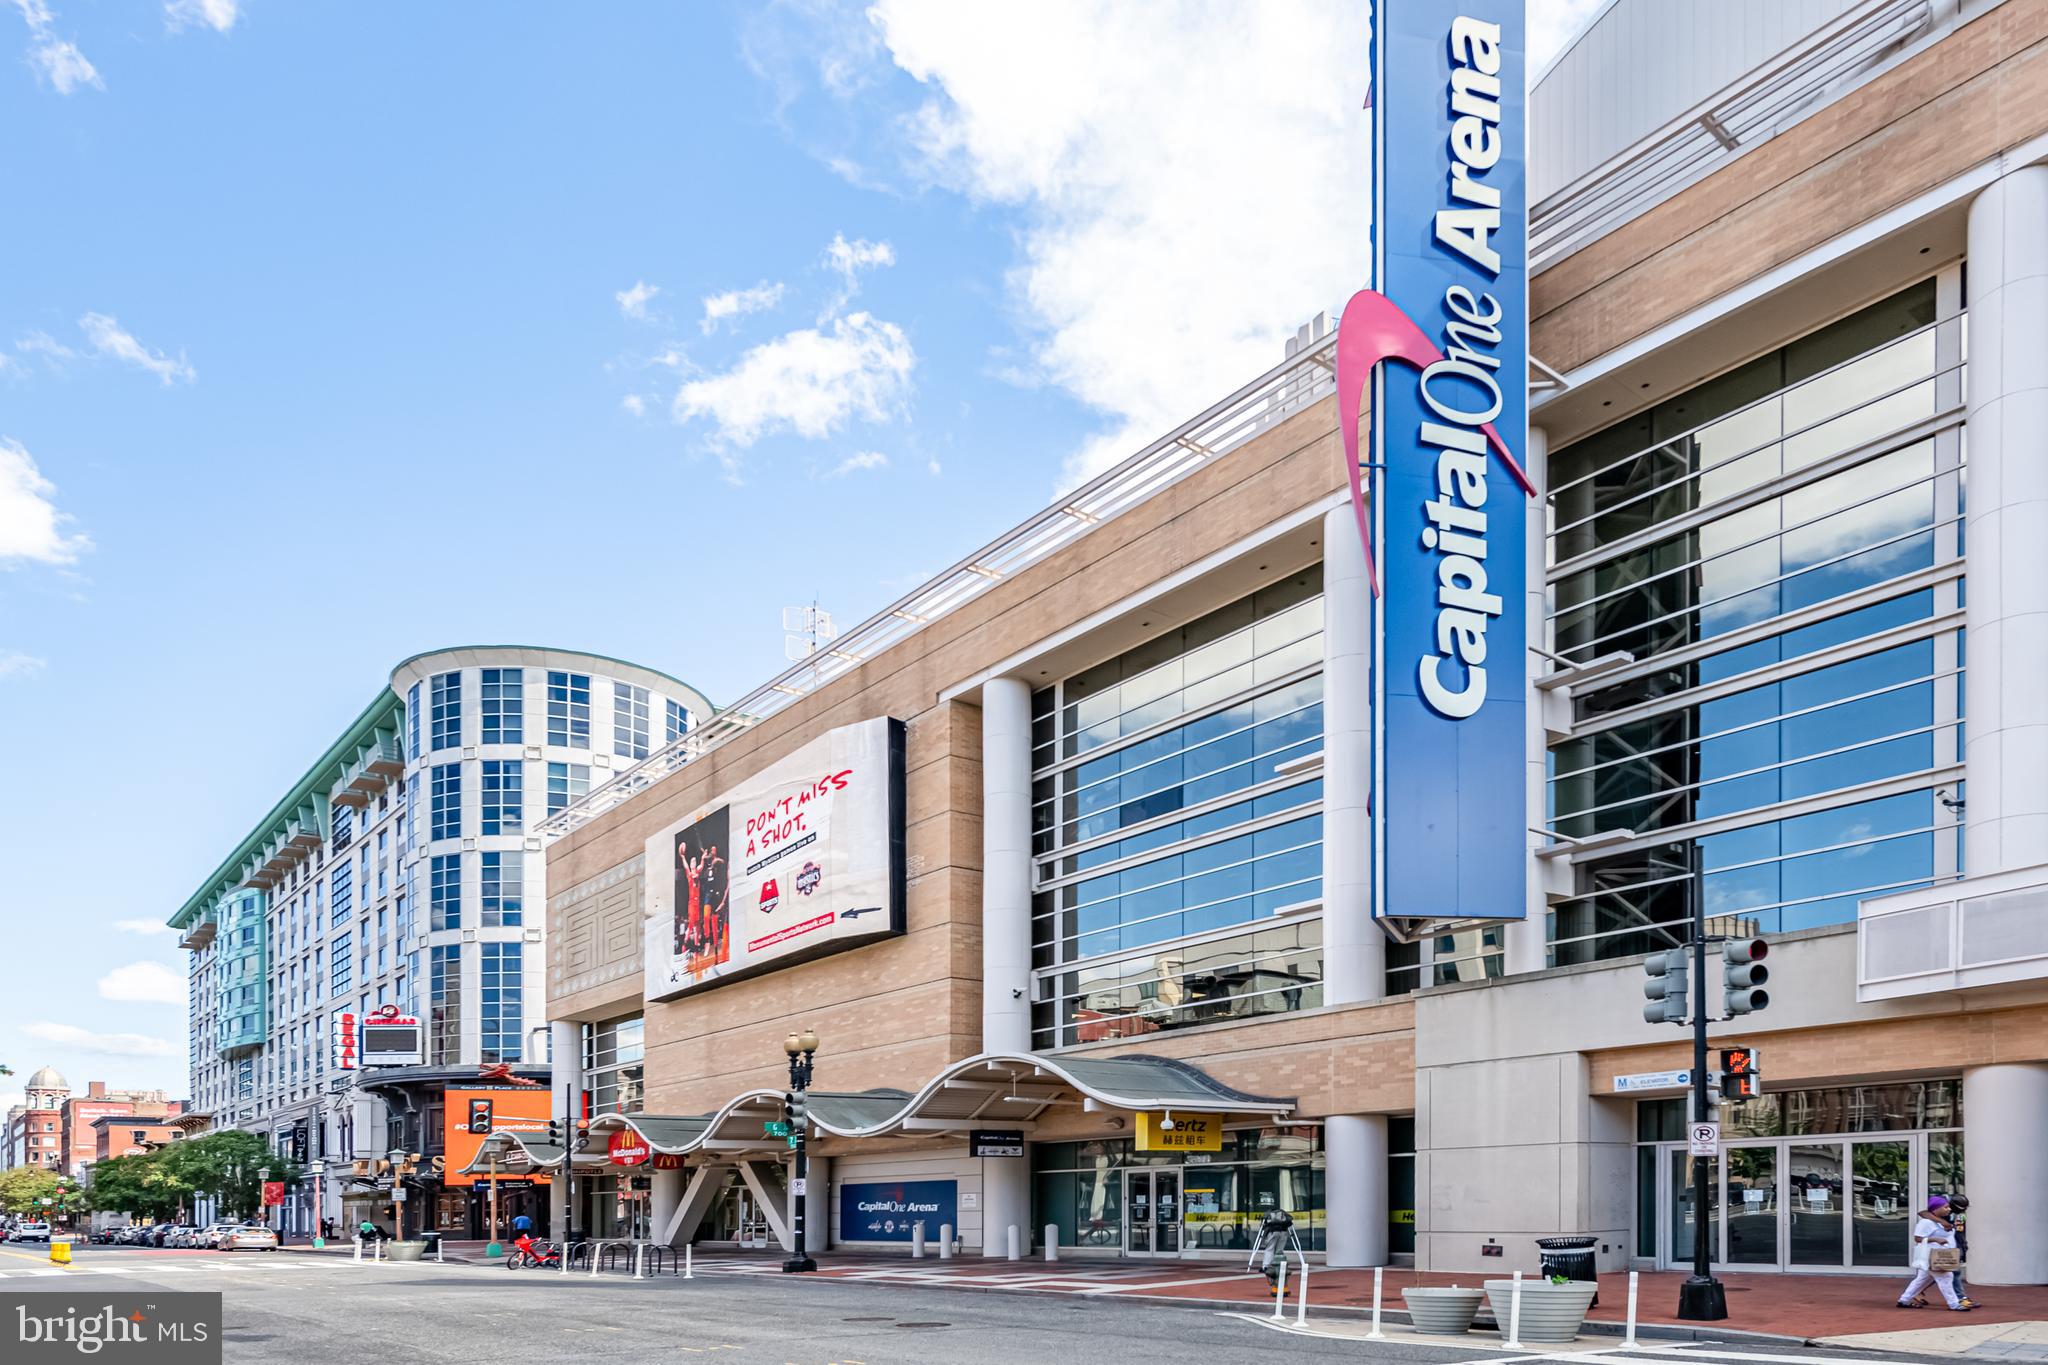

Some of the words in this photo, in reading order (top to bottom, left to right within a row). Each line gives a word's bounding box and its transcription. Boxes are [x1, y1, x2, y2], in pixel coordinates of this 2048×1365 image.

[1435, 15, 1501, 275] Arena
[746, 796, 793, 837] DON'T
[797, 769, 853, 809] MISS
[745, 838, 756, 858] A
[761, 812, 807, 849] SHOT.
[342, 1013, 355, 1069] REGAL
[1618, 1078, 1628, 1087] M
[296, 1128, 306, 1151] LOFT
[612, 1147, 646, 1158] McDonald's
[907, 1202, 939, 1212] Arena
[1196, 1214, 1218, 1222] Hertz
